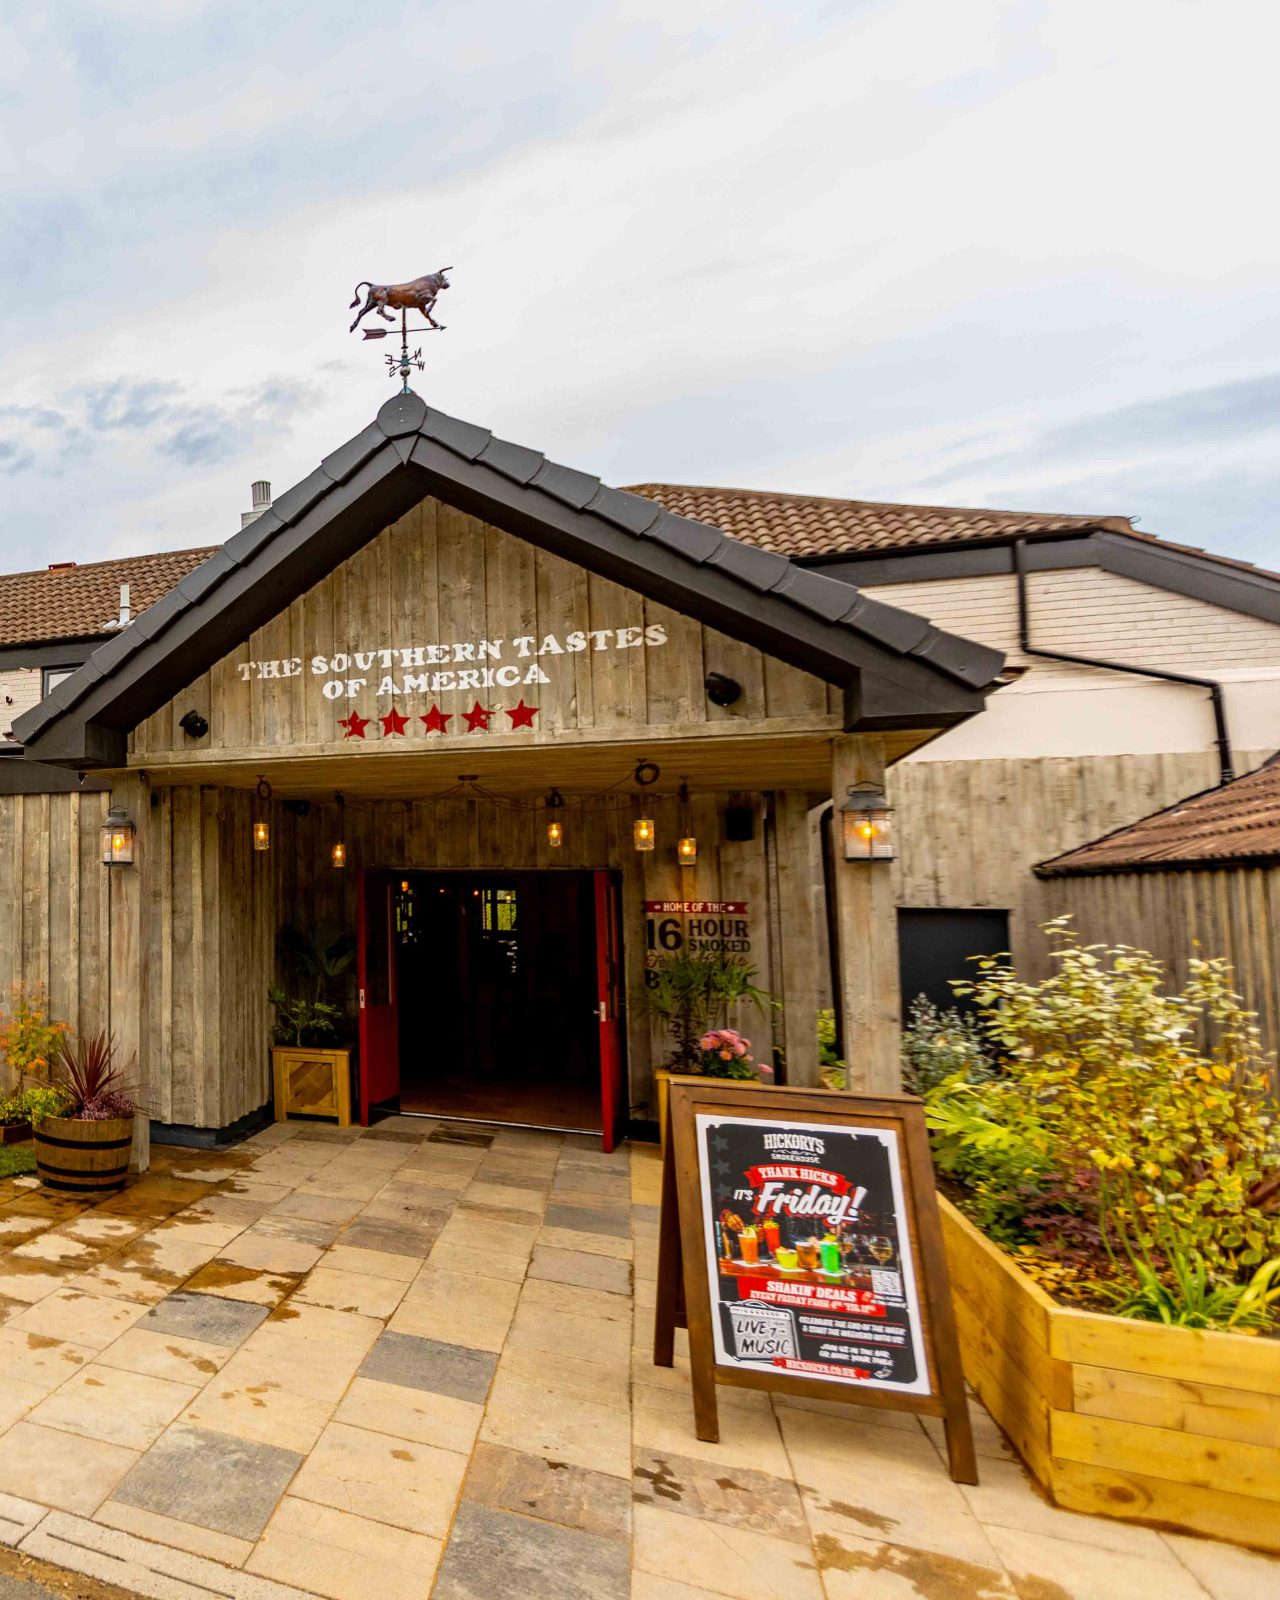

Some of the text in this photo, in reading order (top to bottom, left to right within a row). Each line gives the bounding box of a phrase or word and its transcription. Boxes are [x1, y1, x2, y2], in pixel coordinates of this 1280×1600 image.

[238, 624, 669, 681] THE SOUTHERN TASTES
[322, 663, 551, 700] OF AMERICA
[663, 902, 726, 913] HOME OF THE
[646, 918, 682, 951] 16
[688, 919, 749, 938] HOUR
[689, 939, 751, 953] SMOKED
[771, 1153, 821, 1164] SMOKEHOUSE
[757, 1166, 839, 1186] THANK HICKS
[733, 1181, 868, 1225] IT'S Friday!
[766, 1280, 815, 1296] SHAKIN'
[816, 1286, 857, 1302] DEALS
[737, 1320, 767, 1334] LIVE
[741, 1338, 790, 1354] MUSIC
